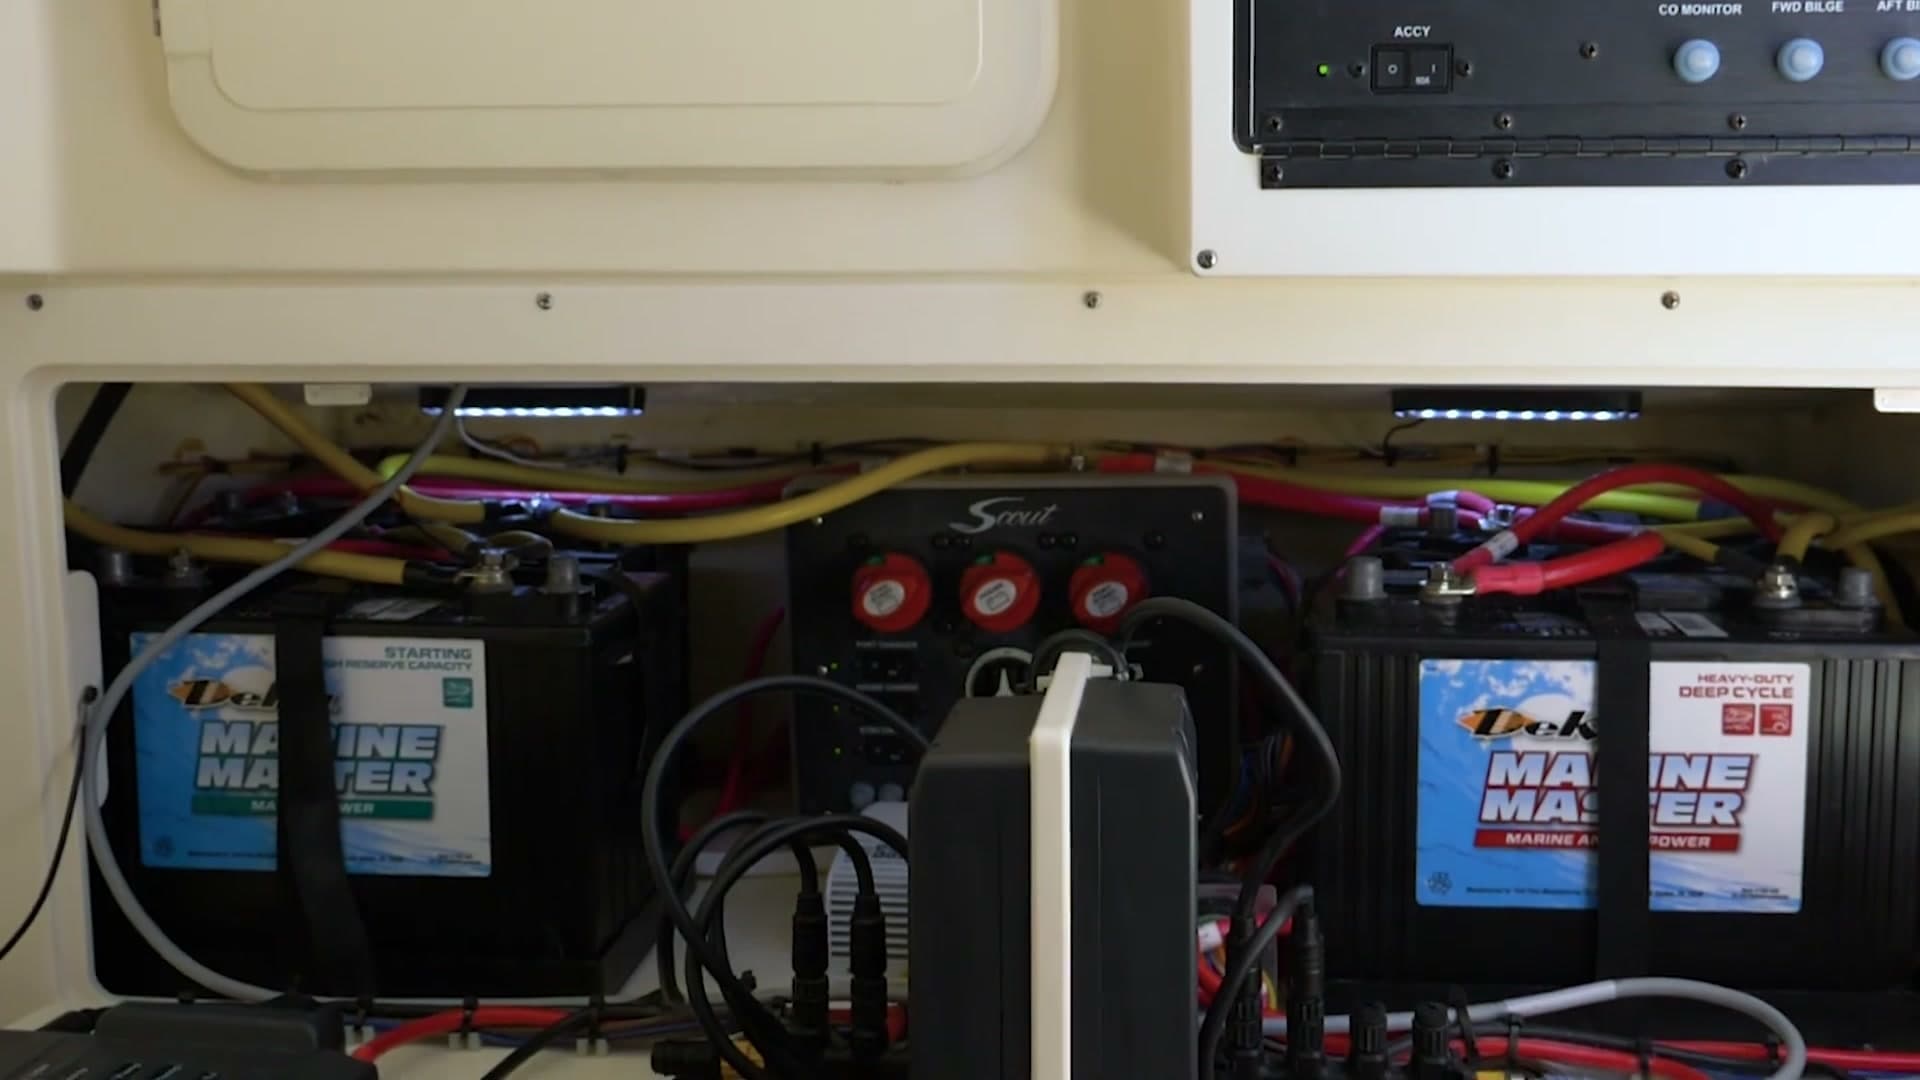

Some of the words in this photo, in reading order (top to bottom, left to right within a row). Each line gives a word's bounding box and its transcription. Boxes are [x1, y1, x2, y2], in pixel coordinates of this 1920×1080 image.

[1658, 3, 1679, 16] CO
[1681, 3, 1742, 16] MONITOR
[1772, 0, 1801, 12] FWD
[1804, 0, 1844, 12] BILGE
[1877, 0, 1903, 12] AFT
[1394, 26, 1430, 38] ACCY
[949, 496, 1061, 534] Scout
[384, 647, 472, 659] STARTING
[345, 659, 404, 669] RESERVE
[408, 660, 472, 671] CAPACITY
[1697, 674, 1793, 684] HEAVY-DUTY
[1679, 686, 1728, 699] DEEP
[1732, 686, 1793, 699] CYCLE
[1462, 708, 1598, 741] Dek
[199, 720, 441, 761] MAINE
[195, 756, 433, 794] MATER
[1485, 751, 1754, 791] MAINE
[1505, 833, 1574, 846] MARINE
